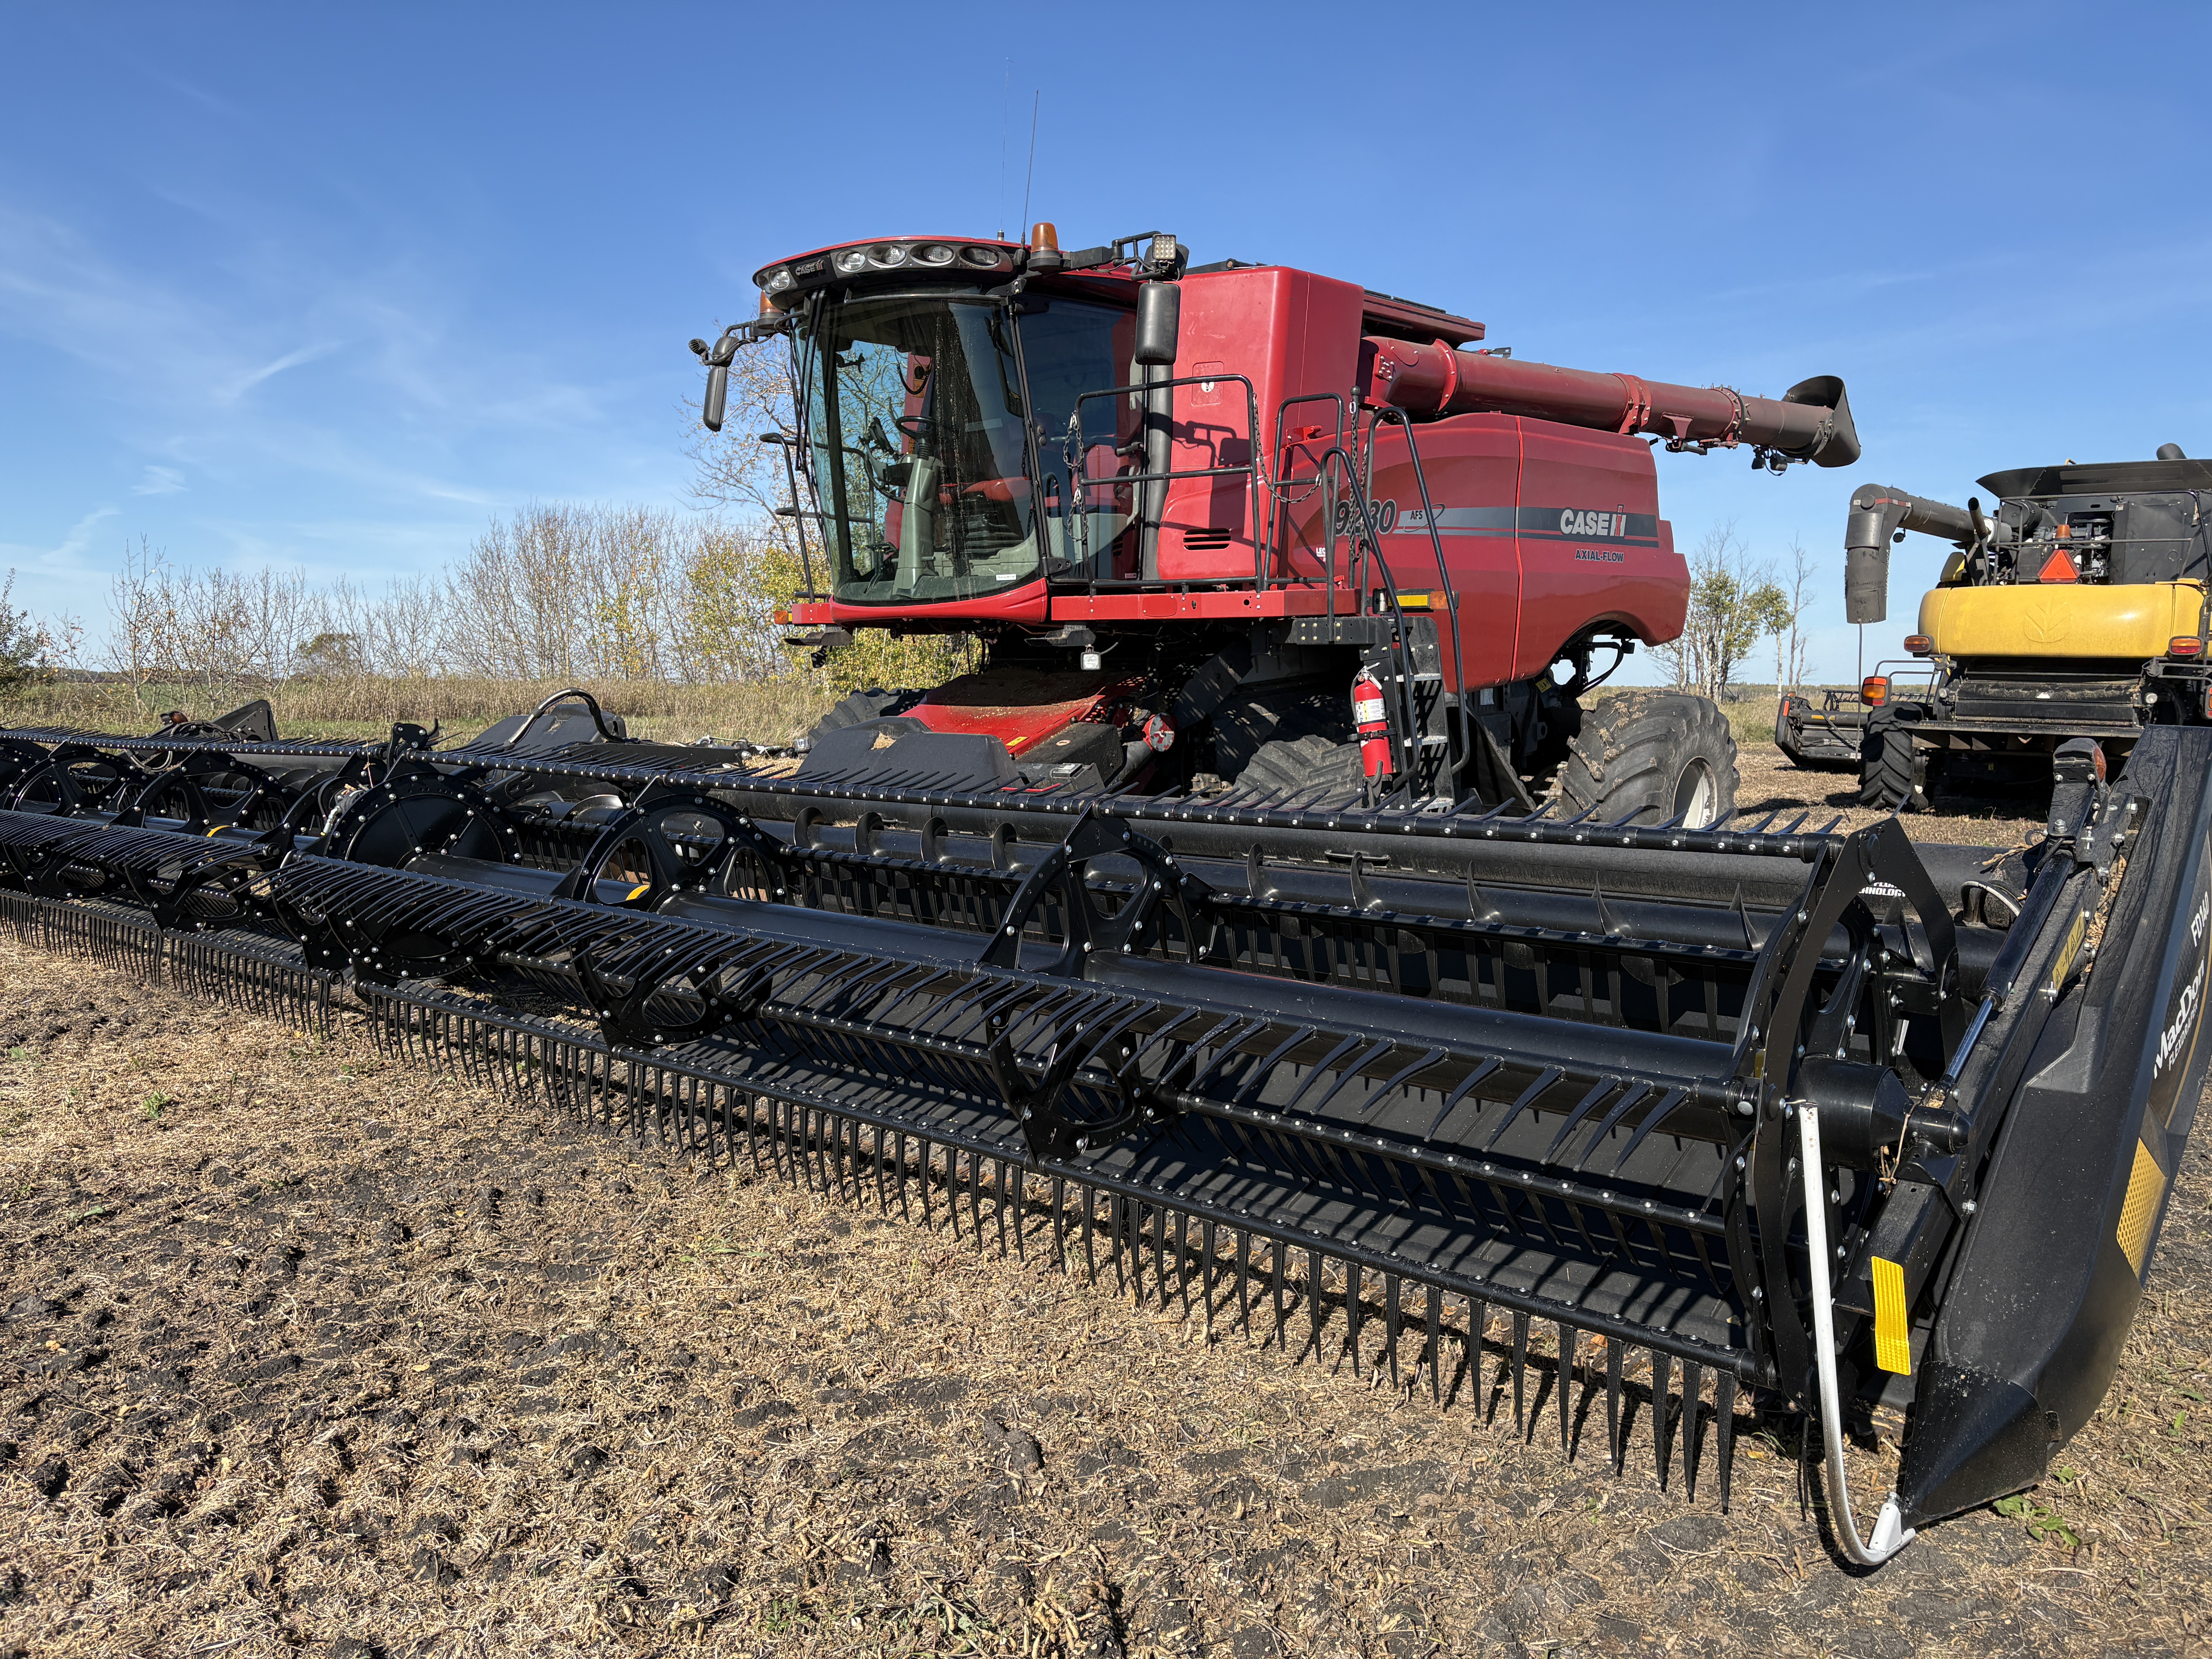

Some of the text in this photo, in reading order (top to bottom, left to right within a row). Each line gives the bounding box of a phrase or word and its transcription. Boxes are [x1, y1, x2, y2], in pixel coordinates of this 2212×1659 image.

[1410, 510, 1423, 520] AFS
[1575, 549, 1624, 563] AXIAL-FLOW
[2191, 891, 2209, 947] FD140
[2154, 959, 2204, 1079] MacDon
